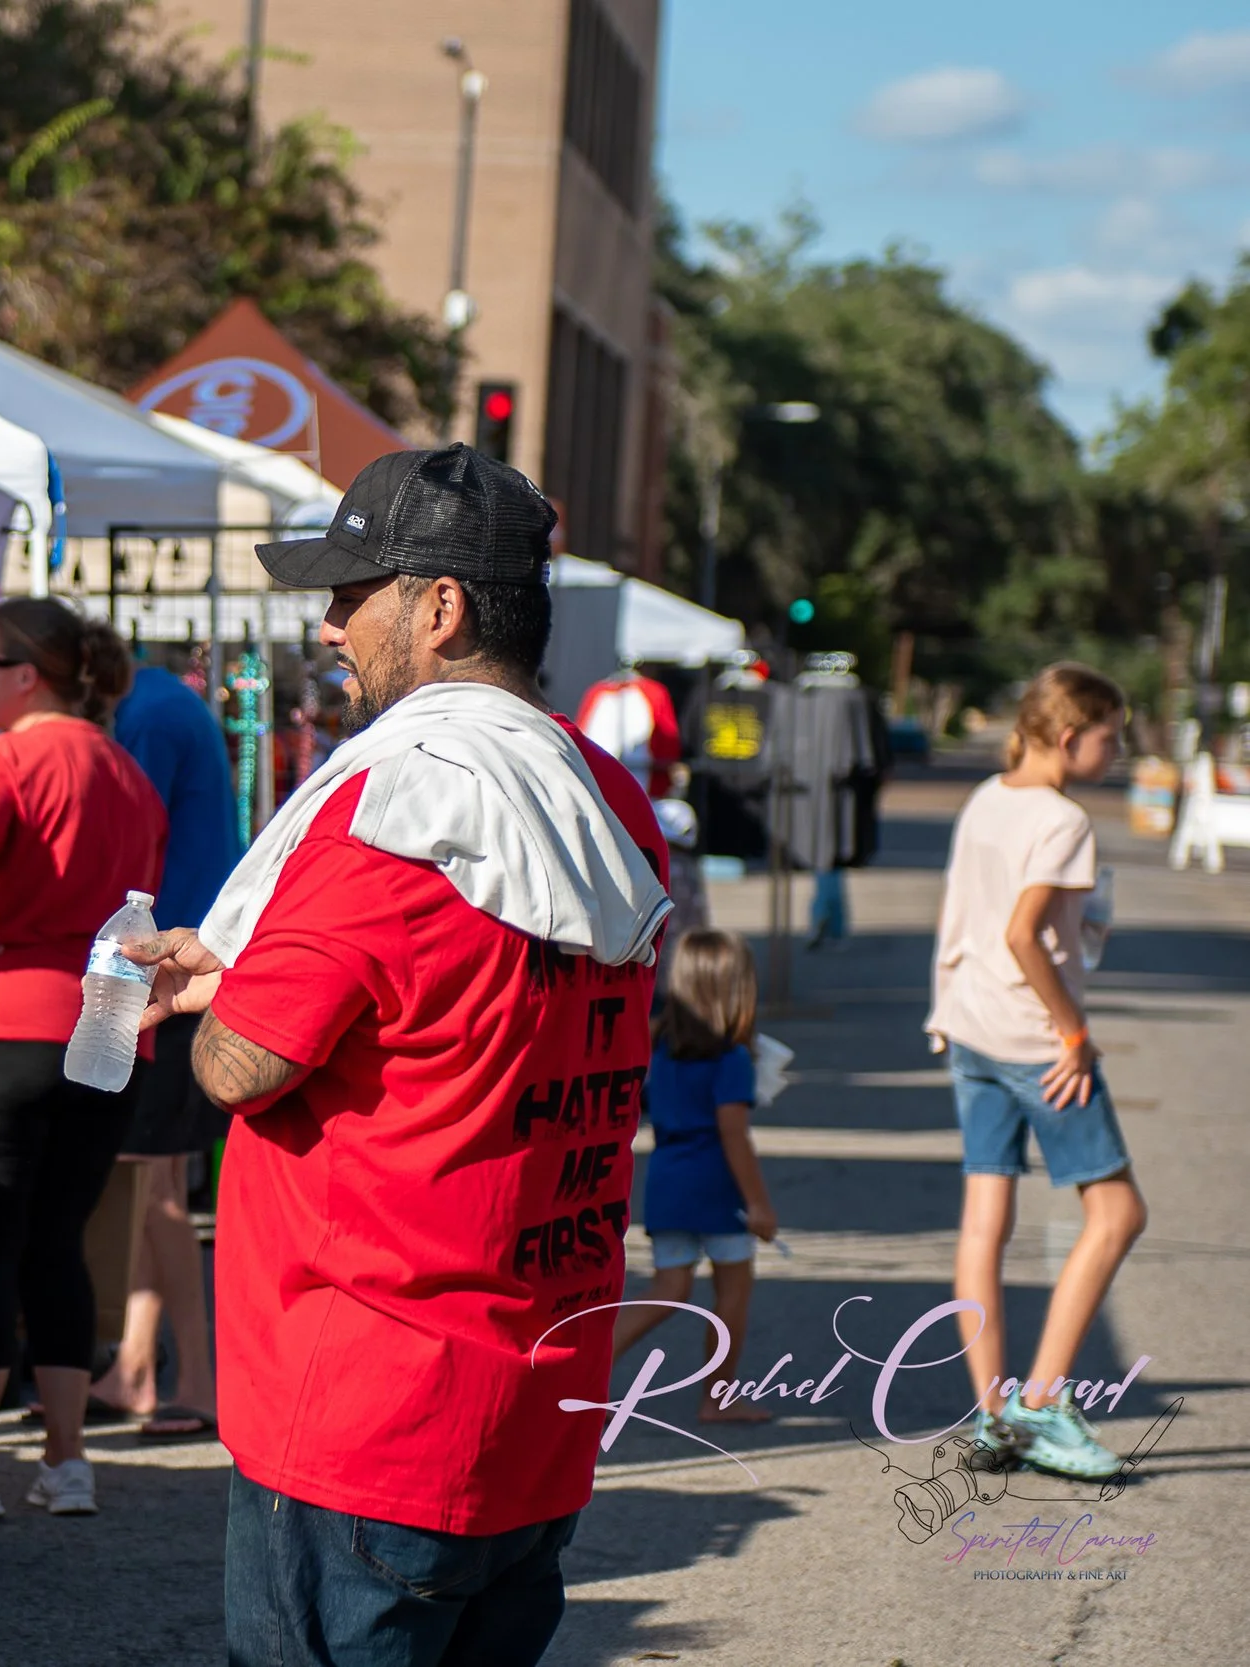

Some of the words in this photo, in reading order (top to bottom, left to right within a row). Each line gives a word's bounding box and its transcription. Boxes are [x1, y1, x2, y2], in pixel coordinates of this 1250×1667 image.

[348, 514, 365, 527] 420
[584, 996, 625, 1058] IT
[553, 1142, 619, 1203] ME
[512, 1199, 627, 1280] FIRST
